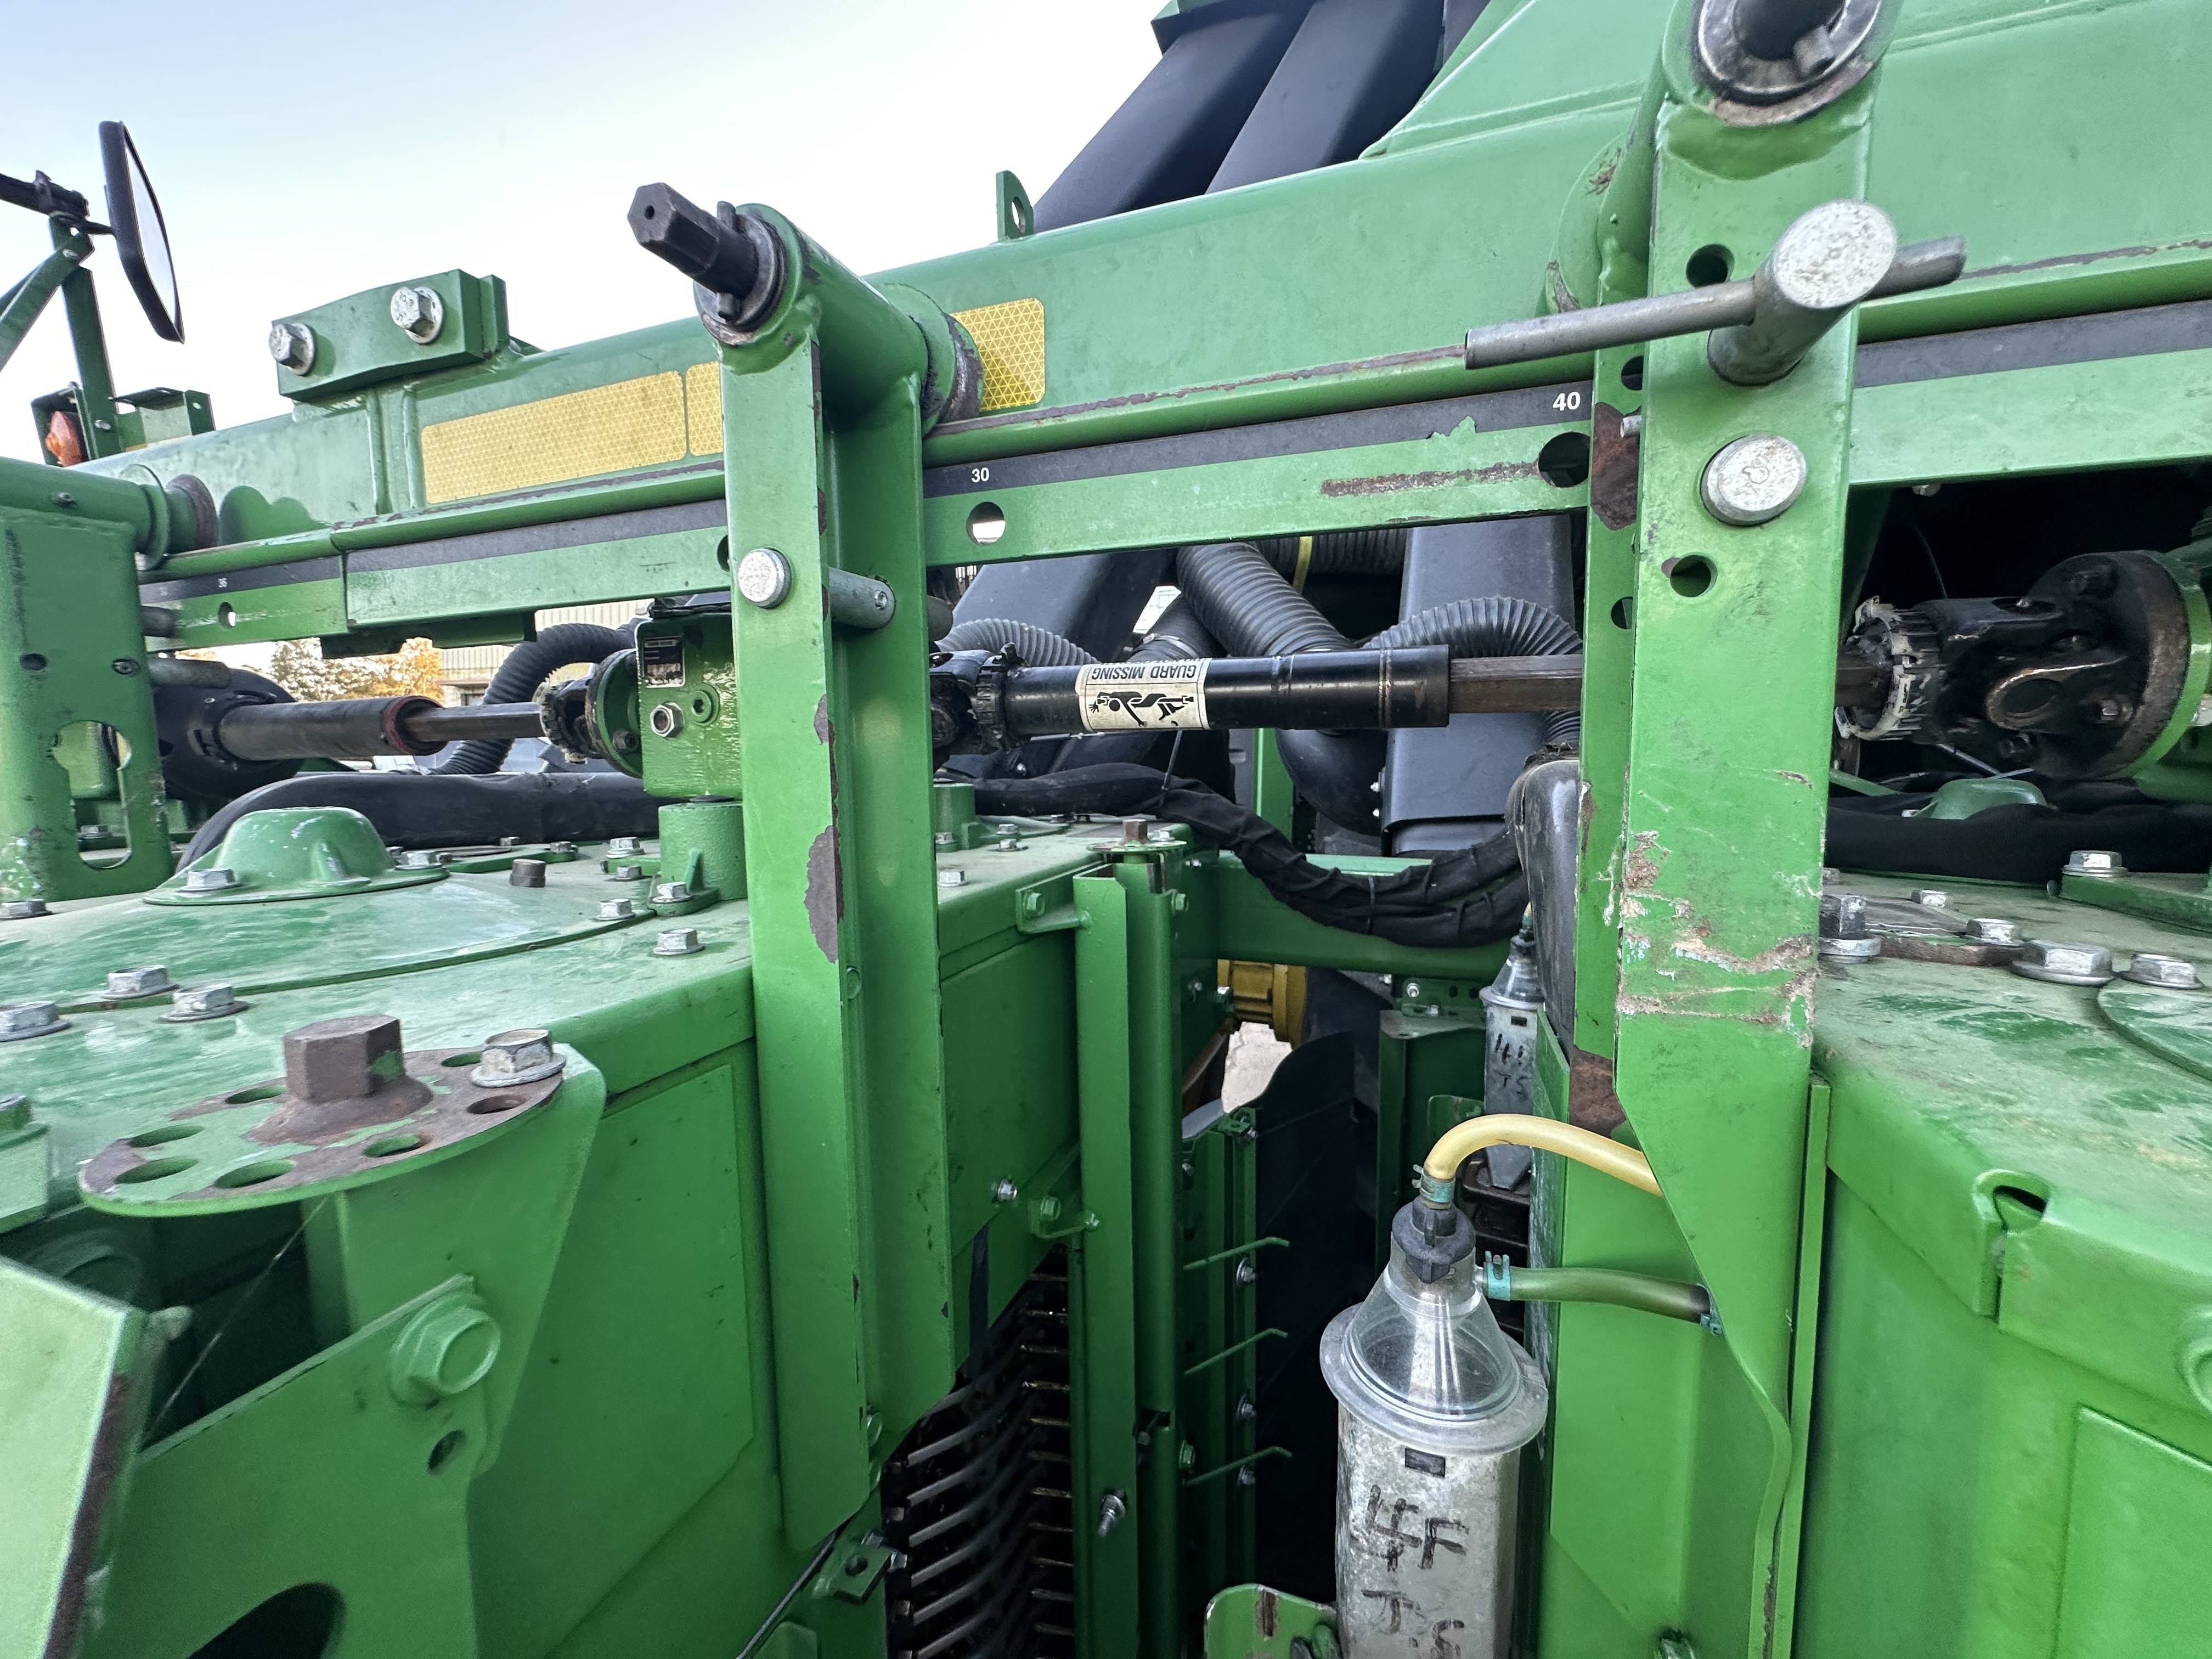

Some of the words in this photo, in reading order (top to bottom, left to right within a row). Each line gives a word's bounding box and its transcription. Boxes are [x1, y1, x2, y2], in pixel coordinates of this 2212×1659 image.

[1553, 391, 1581, 411] 40
[972, 467, 990, 483] 30
[1091, 667, 1146, 680] MISSING
[1150, 665, 1197, 679] GUARD
